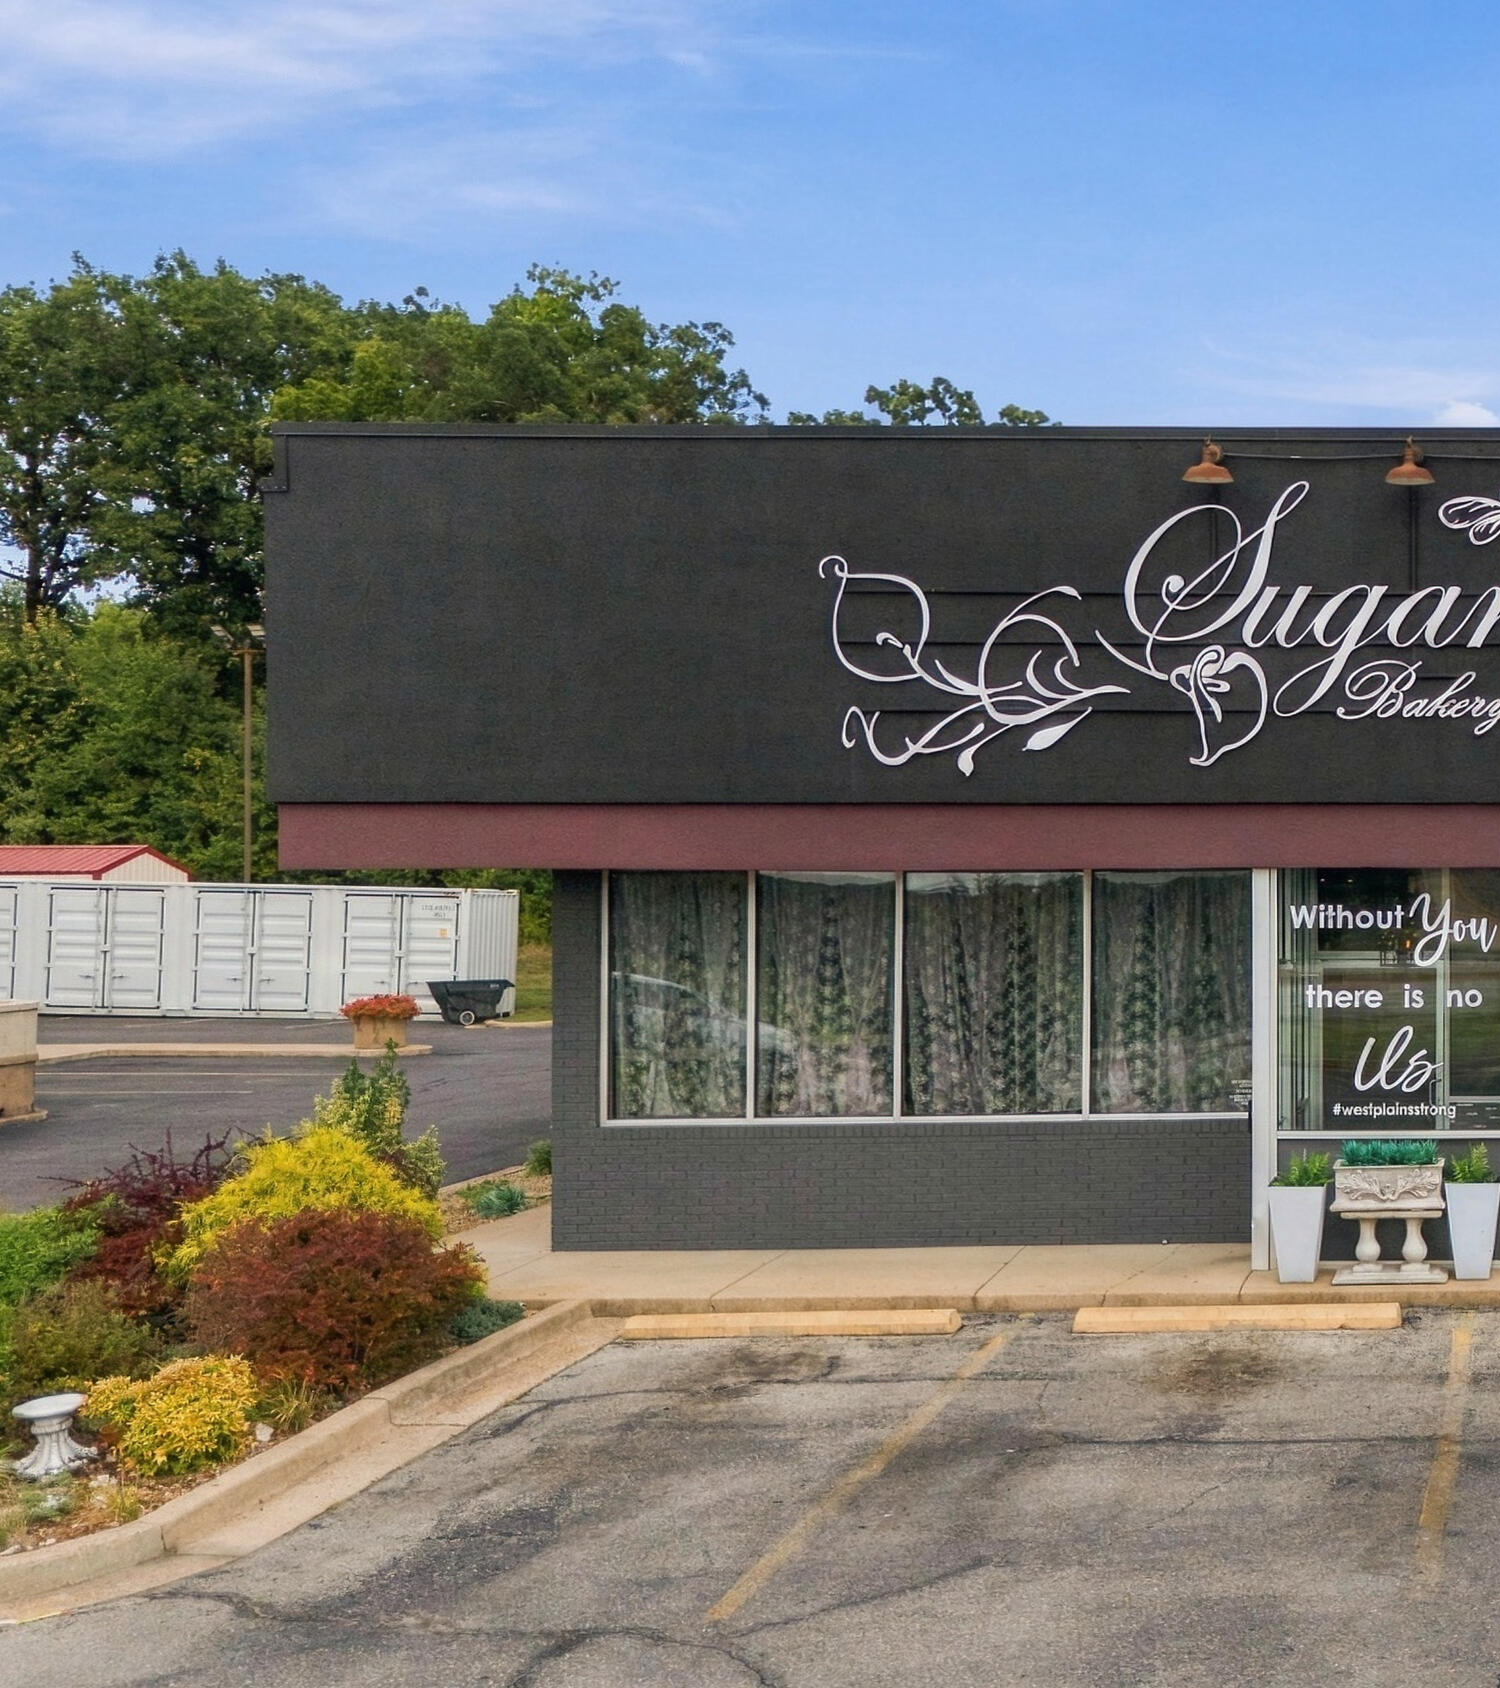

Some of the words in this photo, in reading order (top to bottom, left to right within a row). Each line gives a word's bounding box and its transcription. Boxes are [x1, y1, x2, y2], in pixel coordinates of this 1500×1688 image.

[1289, 904, 1404, 929] Without
[1408, 892, 1498, 967] You
[1305, 984, 1383, 1009] there
[1403, 984, 1424, 1009] is
[1446, 988, 1483, 1008] no
[1354, 1025, 1444, 1093] Us
[1332, 1102, 1457, 1119] #westplainsstrong
